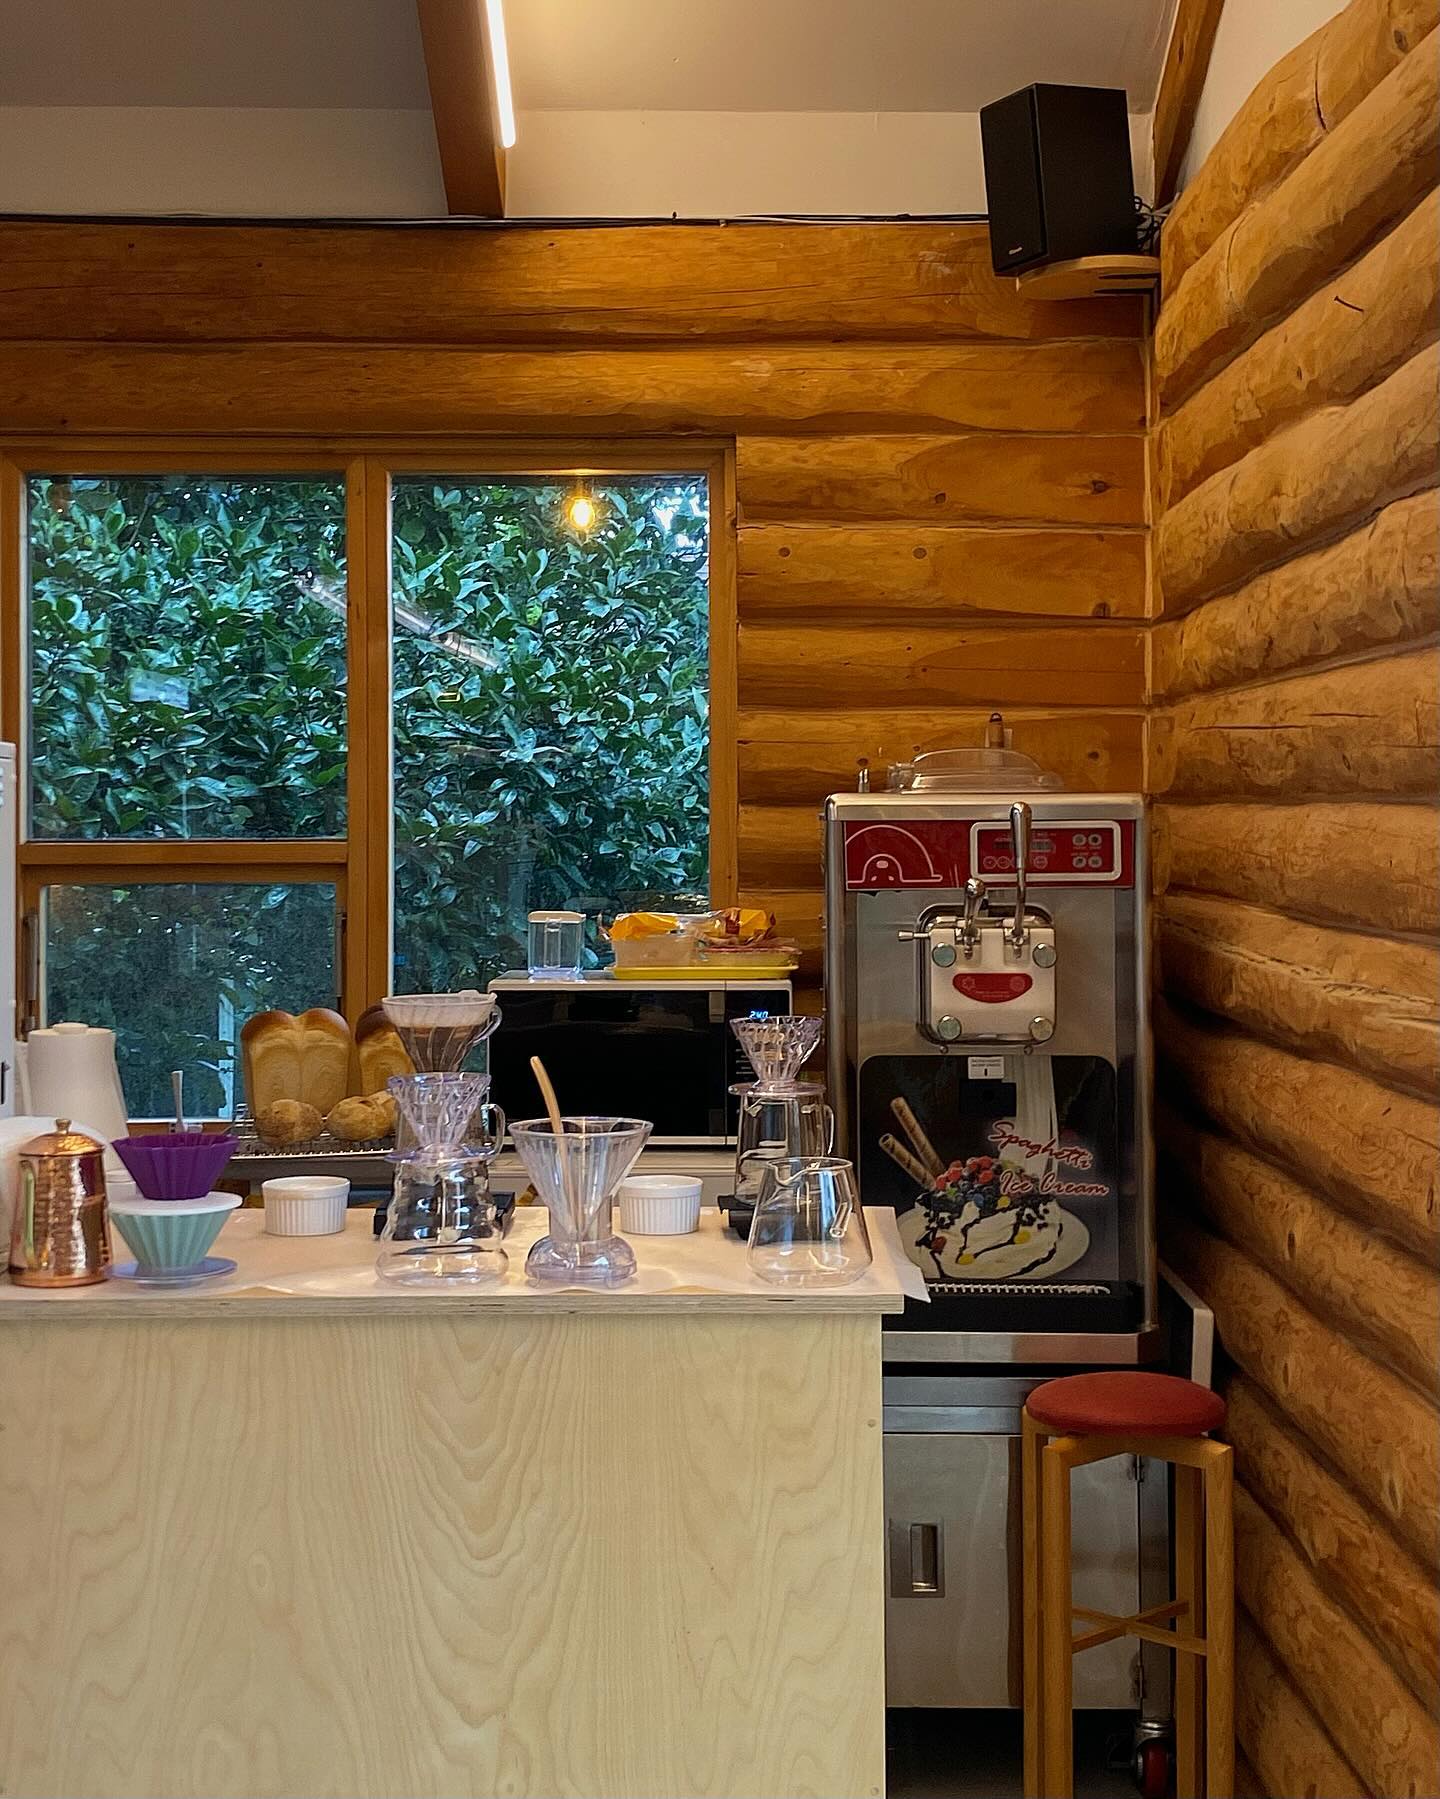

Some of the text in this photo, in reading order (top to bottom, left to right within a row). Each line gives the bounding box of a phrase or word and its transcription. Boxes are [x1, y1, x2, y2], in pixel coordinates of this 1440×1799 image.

[989, 1120, 1091, 1169] Spaghetti
[1001, 1170, 1109, 1195] Ice Cream
